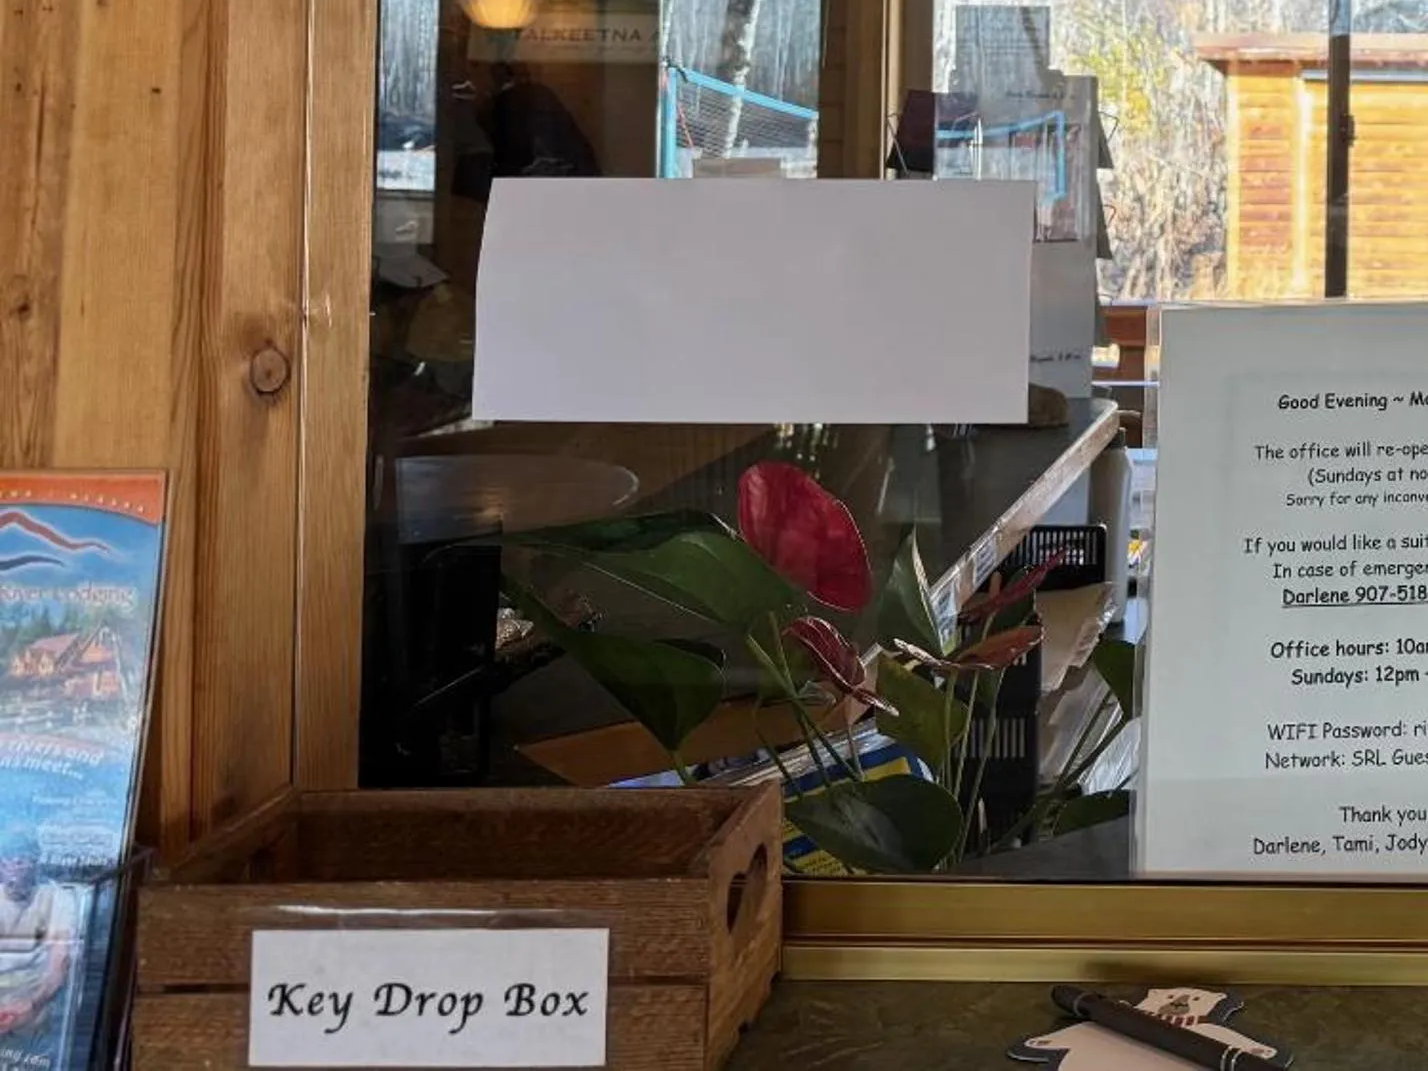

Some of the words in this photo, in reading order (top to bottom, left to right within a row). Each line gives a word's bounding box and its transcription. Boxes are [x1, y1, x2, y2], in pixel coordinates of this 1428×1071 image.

[1277, 393, 1320, 410] Good
[1325, 393, 1389, 411] Evening
[1254, 444, 1284, 462] The
[1288, 441, 1340, 461] office
[1343, 439, 1372, 458] will
[1307, 465, 1383, 487] (Sundays
[1386, 464, 1404, 481] at
[1285, 490, 1326, 509] Sorry
[1329, 490, 1353, 509] for
[1355, 493, 1379, 508] any
[1243, 536, 1263, 554] If
[1267, 538, 1295, 557] you
[1300, 533, 1347, 554] would
[1351, 532, 1383, 552] like
[1386, 538, 1397, 550] a
[1271, 561, 1295, 581] In
[1297, 562, 1334, 578] case
[1339, 560, 1360, 579] of
[1281, 586, 1352, 609] Darlene
[1270, 640, 1331, 659] Office
[1336, 637, 1389, 657] hours:
[1291, 667, 1368, 688] Sundays:
[1375, 664, 1420, 686] 12pm
[1266, 720, 1320, 741] WIFI
[1323, 719, 1408, 740] Password:
[1265, 749, 1348, 770] Network:
[1351, 747, 1387, 768] SRL
[1338, 804, 1394, 825] Thank
[1253, 836, 1326, 857] Darlene,
[1332, 833, 1379, 855] Tami,
[1385, 833, 1428, 855] Jody
[268, 983, 353, 1034] Key
[374, 982, 484, 1035] Drop
[504, 983, 589, 1017] Box
